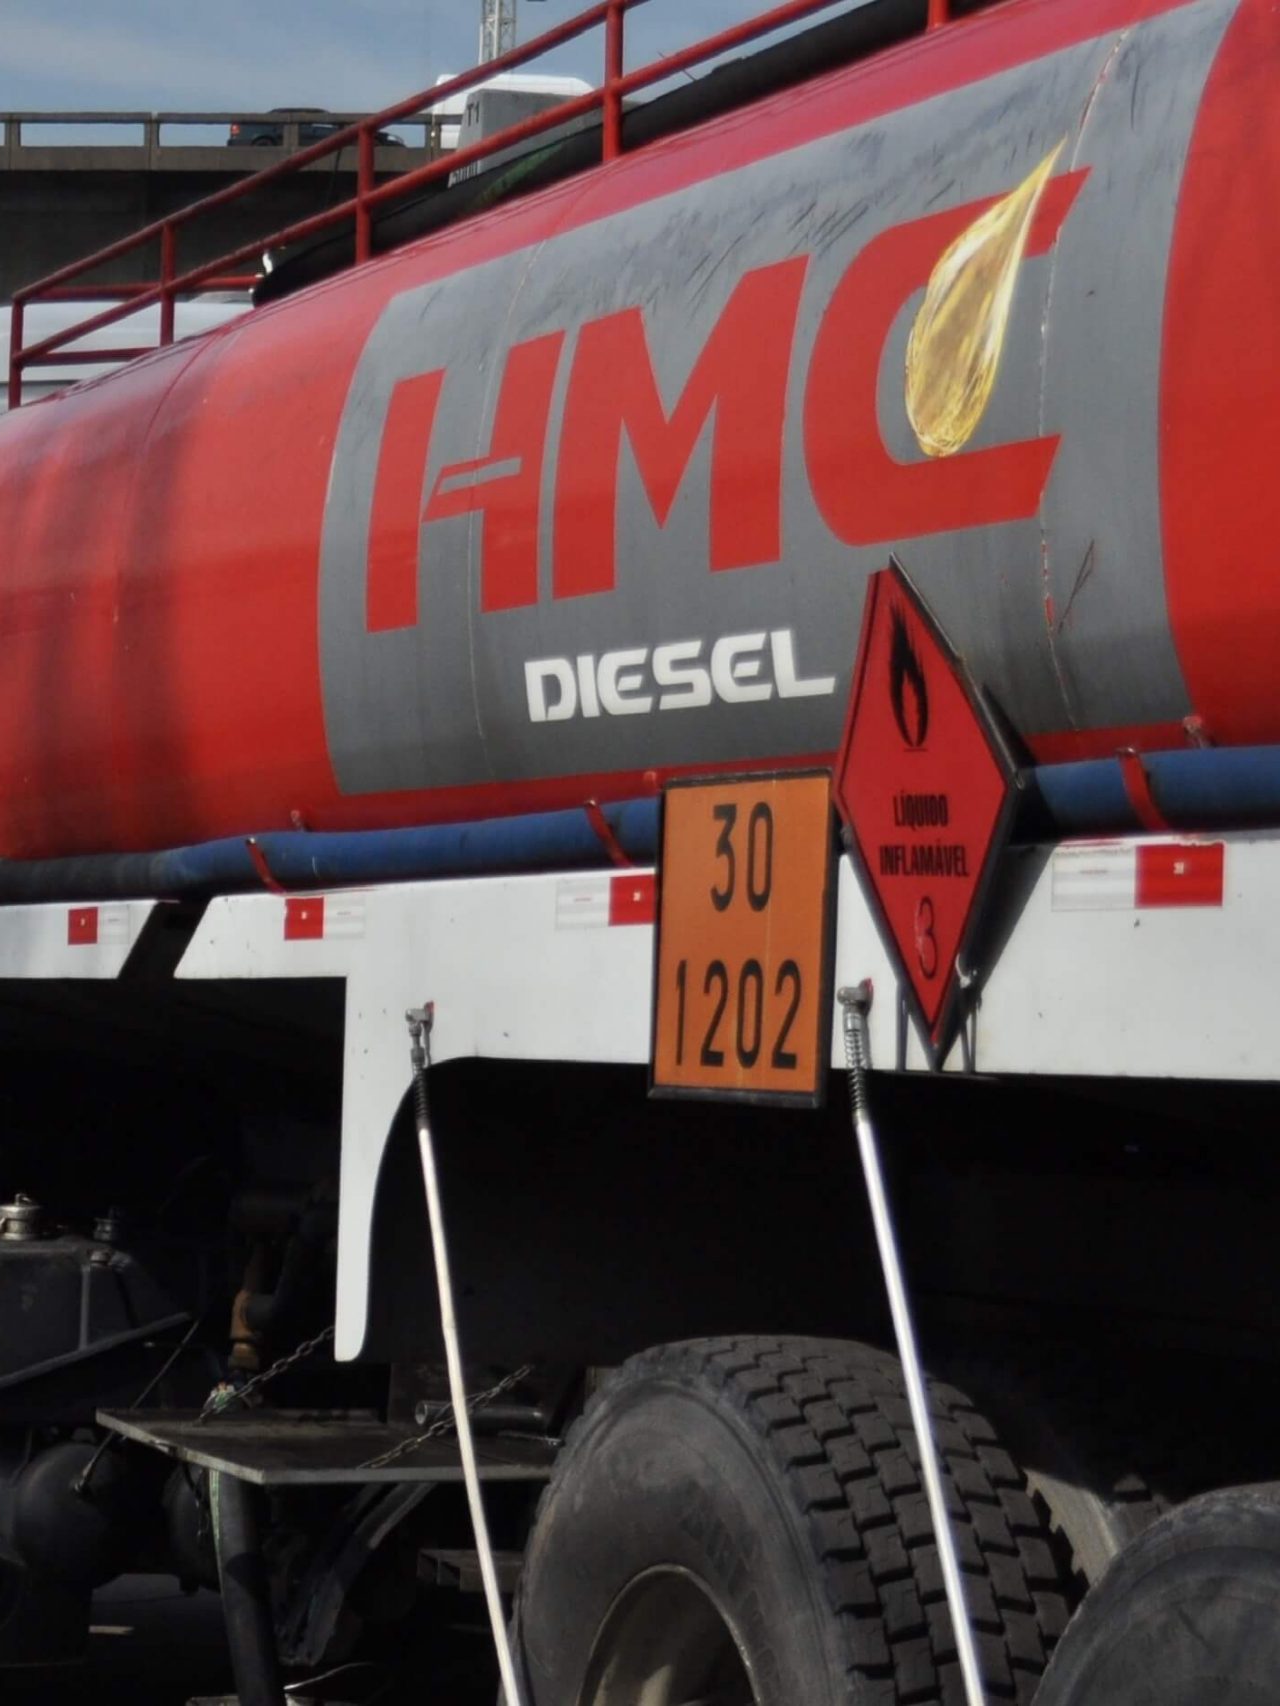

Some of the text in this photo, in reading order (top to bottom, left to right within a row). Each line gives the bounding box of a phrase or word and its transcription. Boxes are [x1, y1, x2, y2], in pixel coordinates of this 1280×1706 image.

[366, 165, 1093, 634] HMC
[524, 629, 835, 723] DIESEL
[710, 801, 774, 912] 30
[893, 790, 949, 831] LÍQUIDO
[879, 839, 970, 877] INFLAMÁVEL
[918, 895, 938, 980] 3
[675, 957, 802, 1070] 1202
